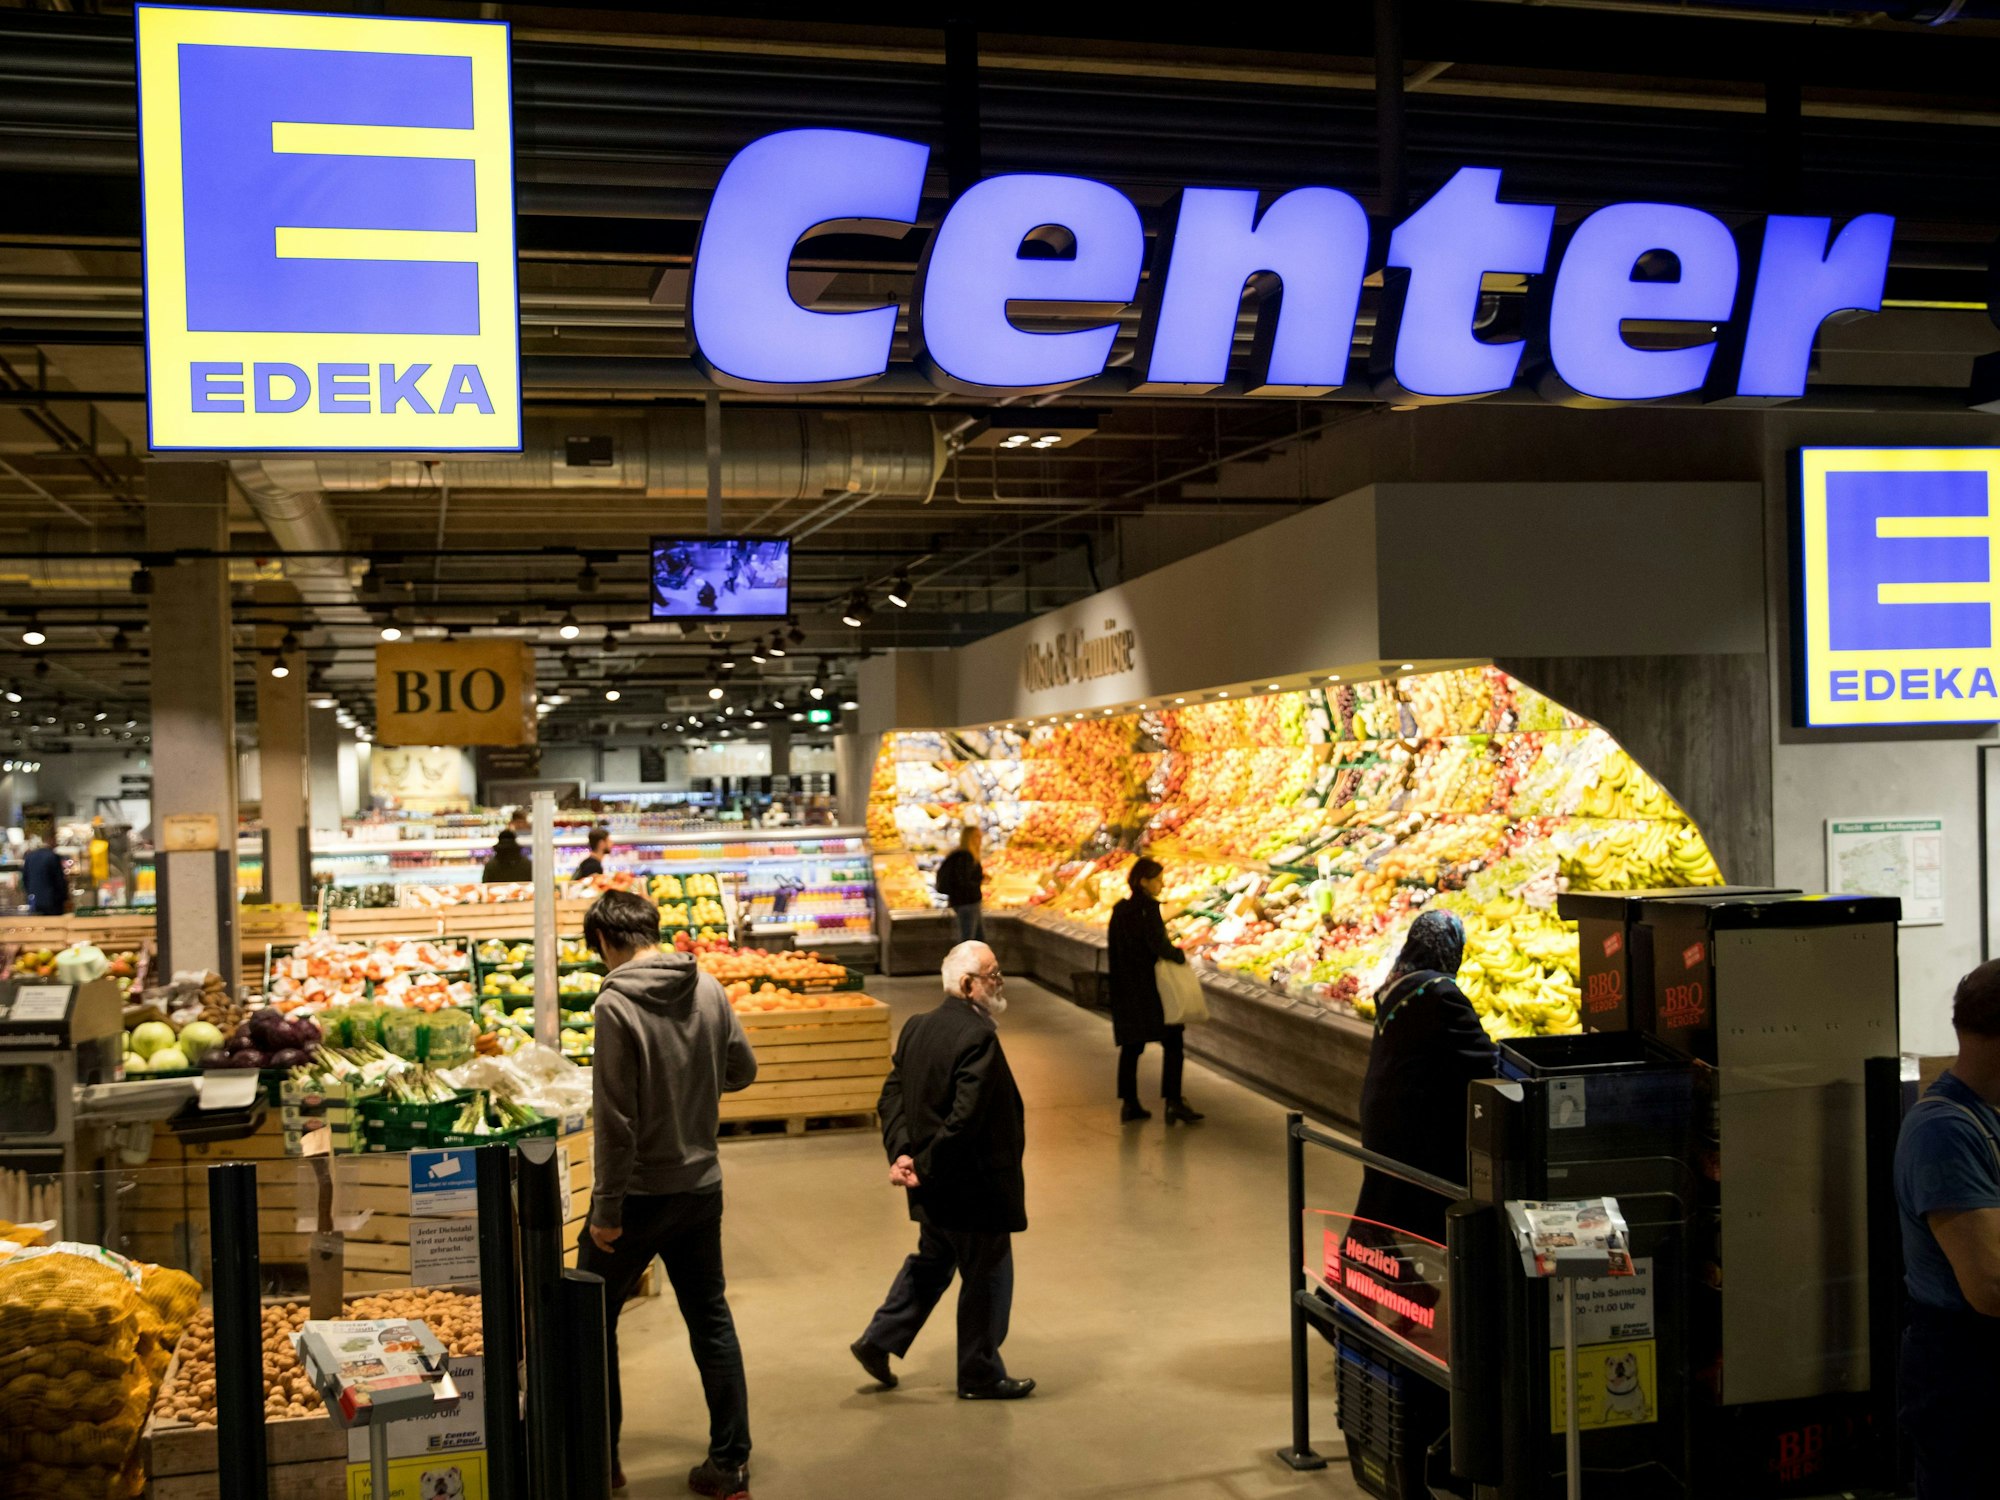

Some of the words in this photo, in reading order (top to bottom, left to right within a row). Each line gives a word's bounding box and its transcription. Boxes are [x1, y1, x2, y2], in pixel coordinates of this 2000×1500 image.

[178, 43, 481, 336] E
[691, 128, 1896, 400] Center
[190, 361, 496, 415] EDEKA
[1825, 470, 1992, 651] E
[393, 667, 506, 715] BIO
[1829, 667, 1999, 702] EDEKA
[1588, 969, 1621, 997] BBQ
[1665, 982, 1703, 1011] BBQ
[1589, 999, 1619, 1014] HEROES
[1667, 1013, 1701, 1029] HEROES
[416, 1237, 433, 1245] wird
[448, 1234, 475, 1242] Anzeige
[418, 1227, 437, 1236] Jeder
[439, 1224, 472, 1234] Diebstahl
[430, 1245, 463, 1255] gebracht.
[1346, 1236, 1400, 1279] Herzlich
[1592, 1289, 1606, 1299] bis
[1607, 1286, 1647, 1298] Samstag
[1594, 1303, 1618, 1313] 21.00
[1619, 1301, 1636, 1311] Uhr
[445, 1431, 478, 1439] Center
